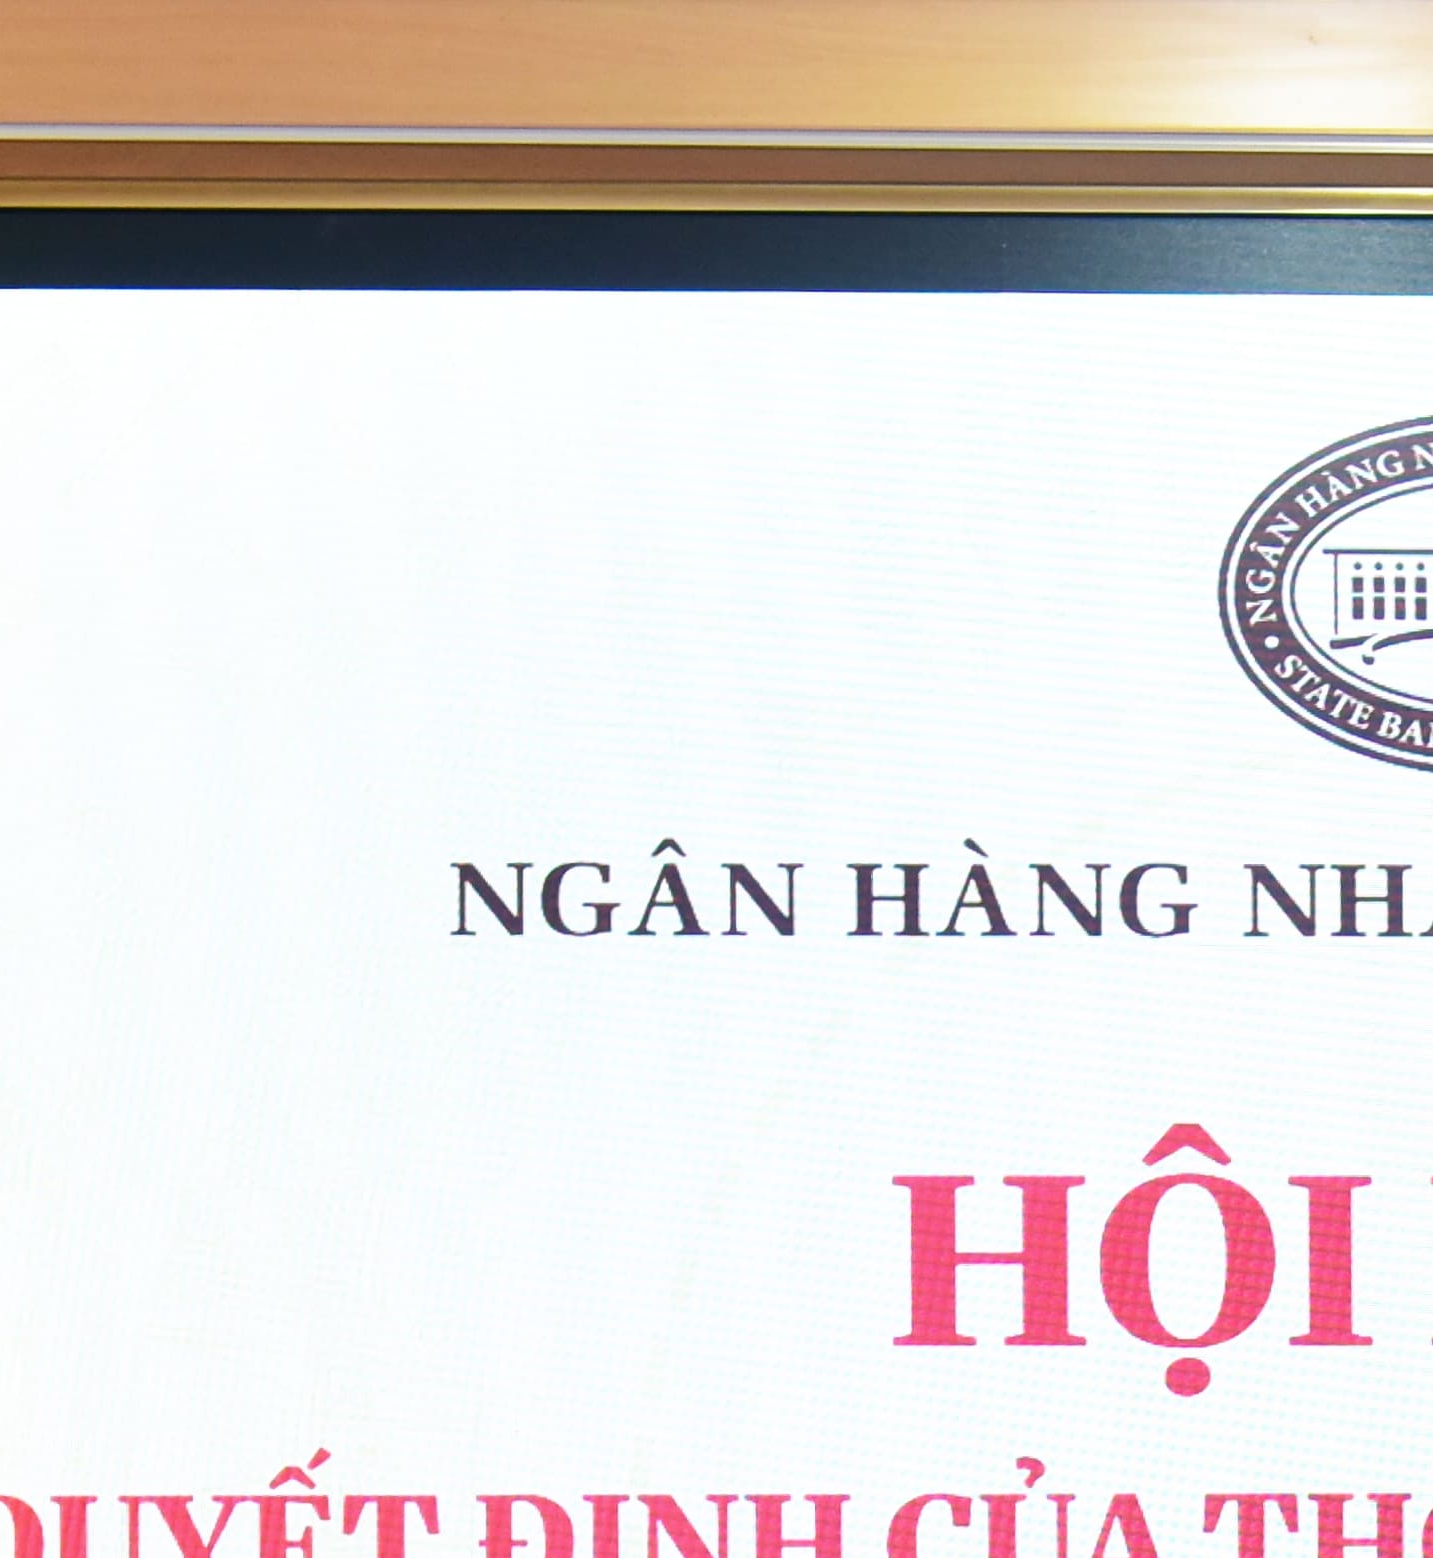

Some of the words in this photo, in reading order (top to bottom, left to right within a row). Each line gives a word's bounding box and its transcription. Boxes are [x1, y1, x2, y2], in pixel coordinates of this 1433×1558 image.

[1246, 512, 1301, 627] NGÂN
[1294, 450, 1405, 518] HÀNG
[1274, 654, 1371, 729] STATE
[451, 838, 803, 938] NGÂN
[847, 838, 1198, 939] HÀNG
[892, 1123, 1373, 1397] HỘI
